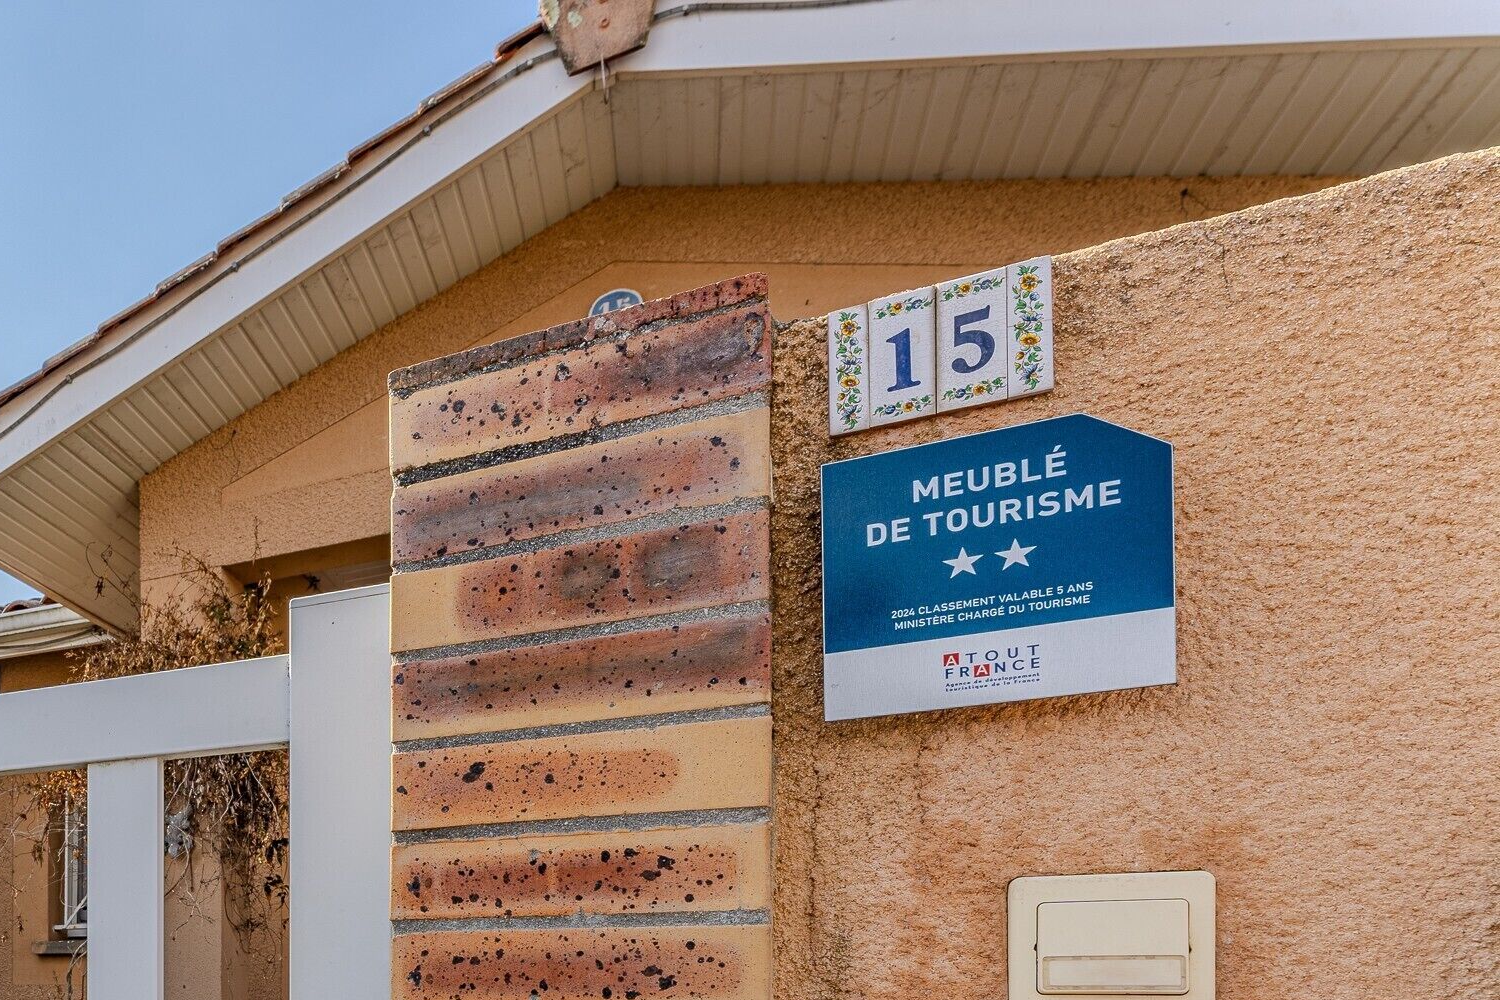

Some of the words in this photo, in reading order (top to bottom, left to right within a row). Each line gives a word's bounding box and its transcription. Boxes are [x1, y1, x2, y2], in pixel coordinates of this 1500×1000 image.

[886, 304, 996, 393] 15
[912, 445, 1068, 504] MEUBLÉ
[866, 517, 911, 548] DE
[923, 479, 1122, 537] TOURISME
[891, 607, 916, 619] 2024
[918, 596, 996, 615] CLASSEMENT
[998, 587, 1054, 604] VALABLE
[1056, 585, 1064, 595] 5
[1067, 581, 1094, 594] ANS
[894, 613, 955, 631] MINISTÈRE
[957, 605, 1006, 622] CHARGÉ
[1008, 604, 1026, 615] DU
[1028, 594, 1091, 612] TOURISME
[945, 658, 1040, 679] FRANCE
[985, 672, 1040, 683] développement
[945, 684, 988, 693] touristique
